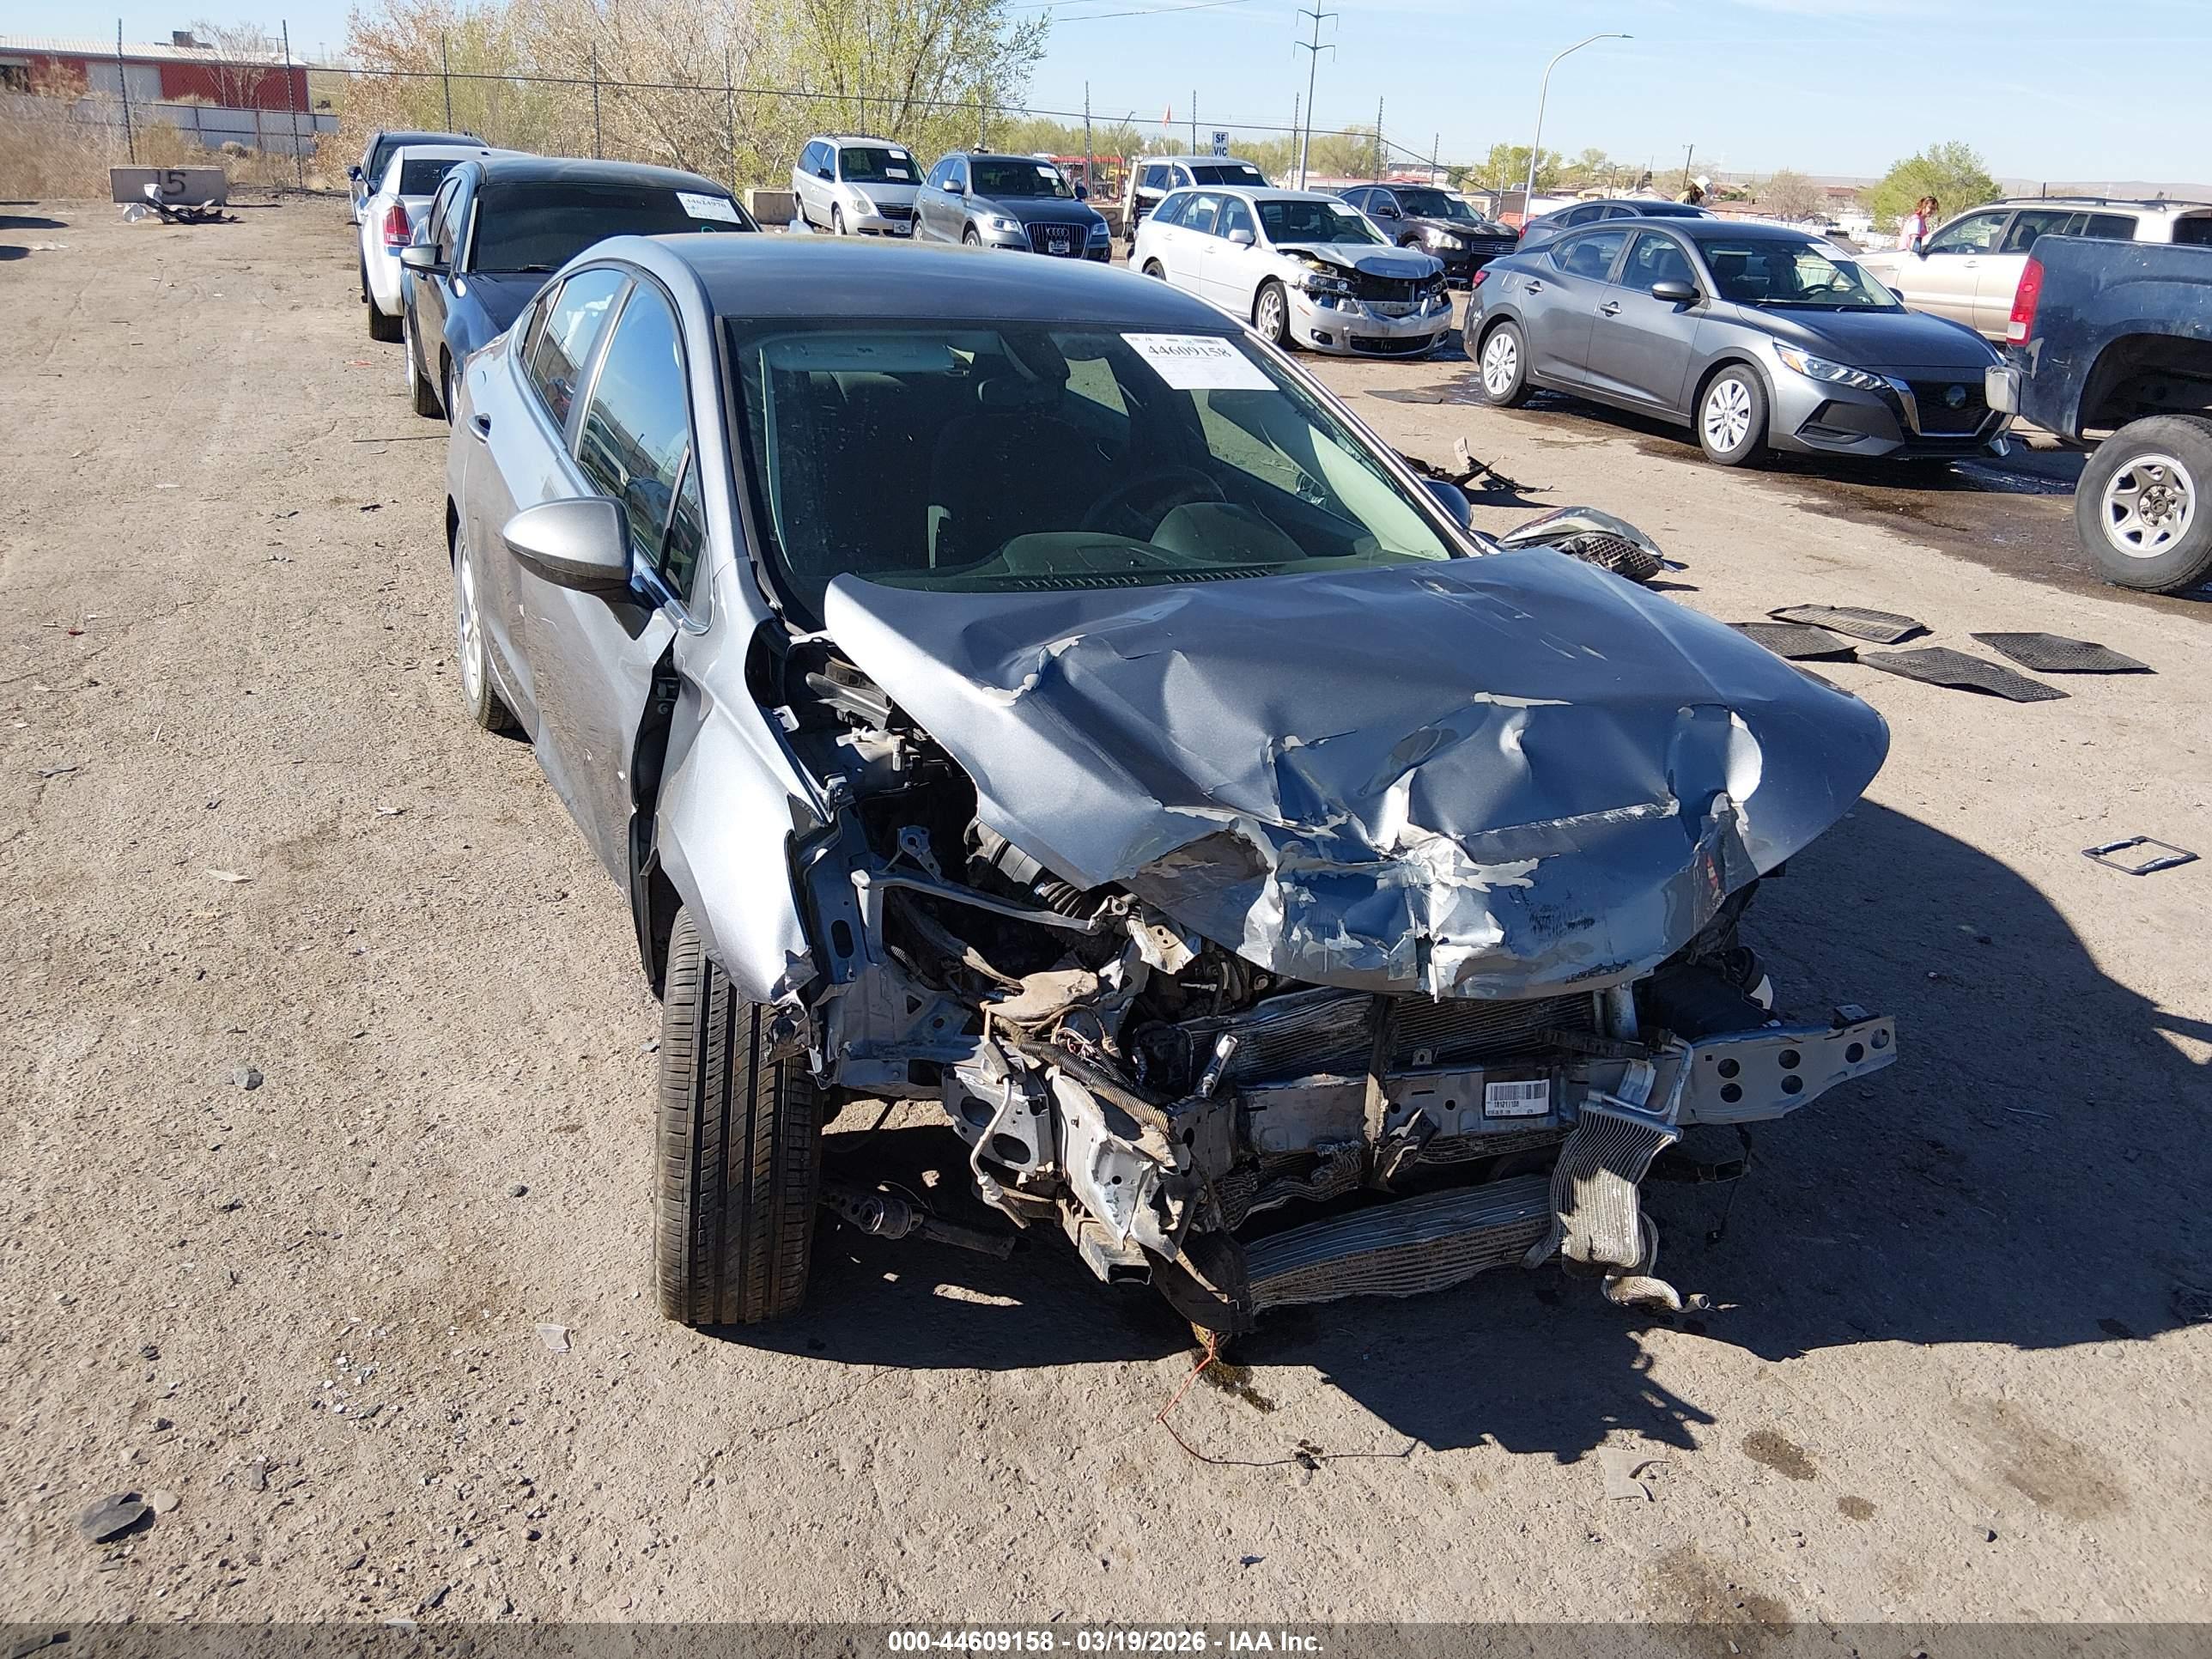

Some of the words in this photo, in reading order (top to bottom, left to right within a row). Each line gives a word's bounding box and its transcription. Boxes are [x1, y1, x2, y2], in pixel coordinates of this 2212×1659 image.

[1215, 133, 1225, 144] SF
[1213, 146, 1227, 157] VIC
[1148, 344, 1232, 358] 44609158
